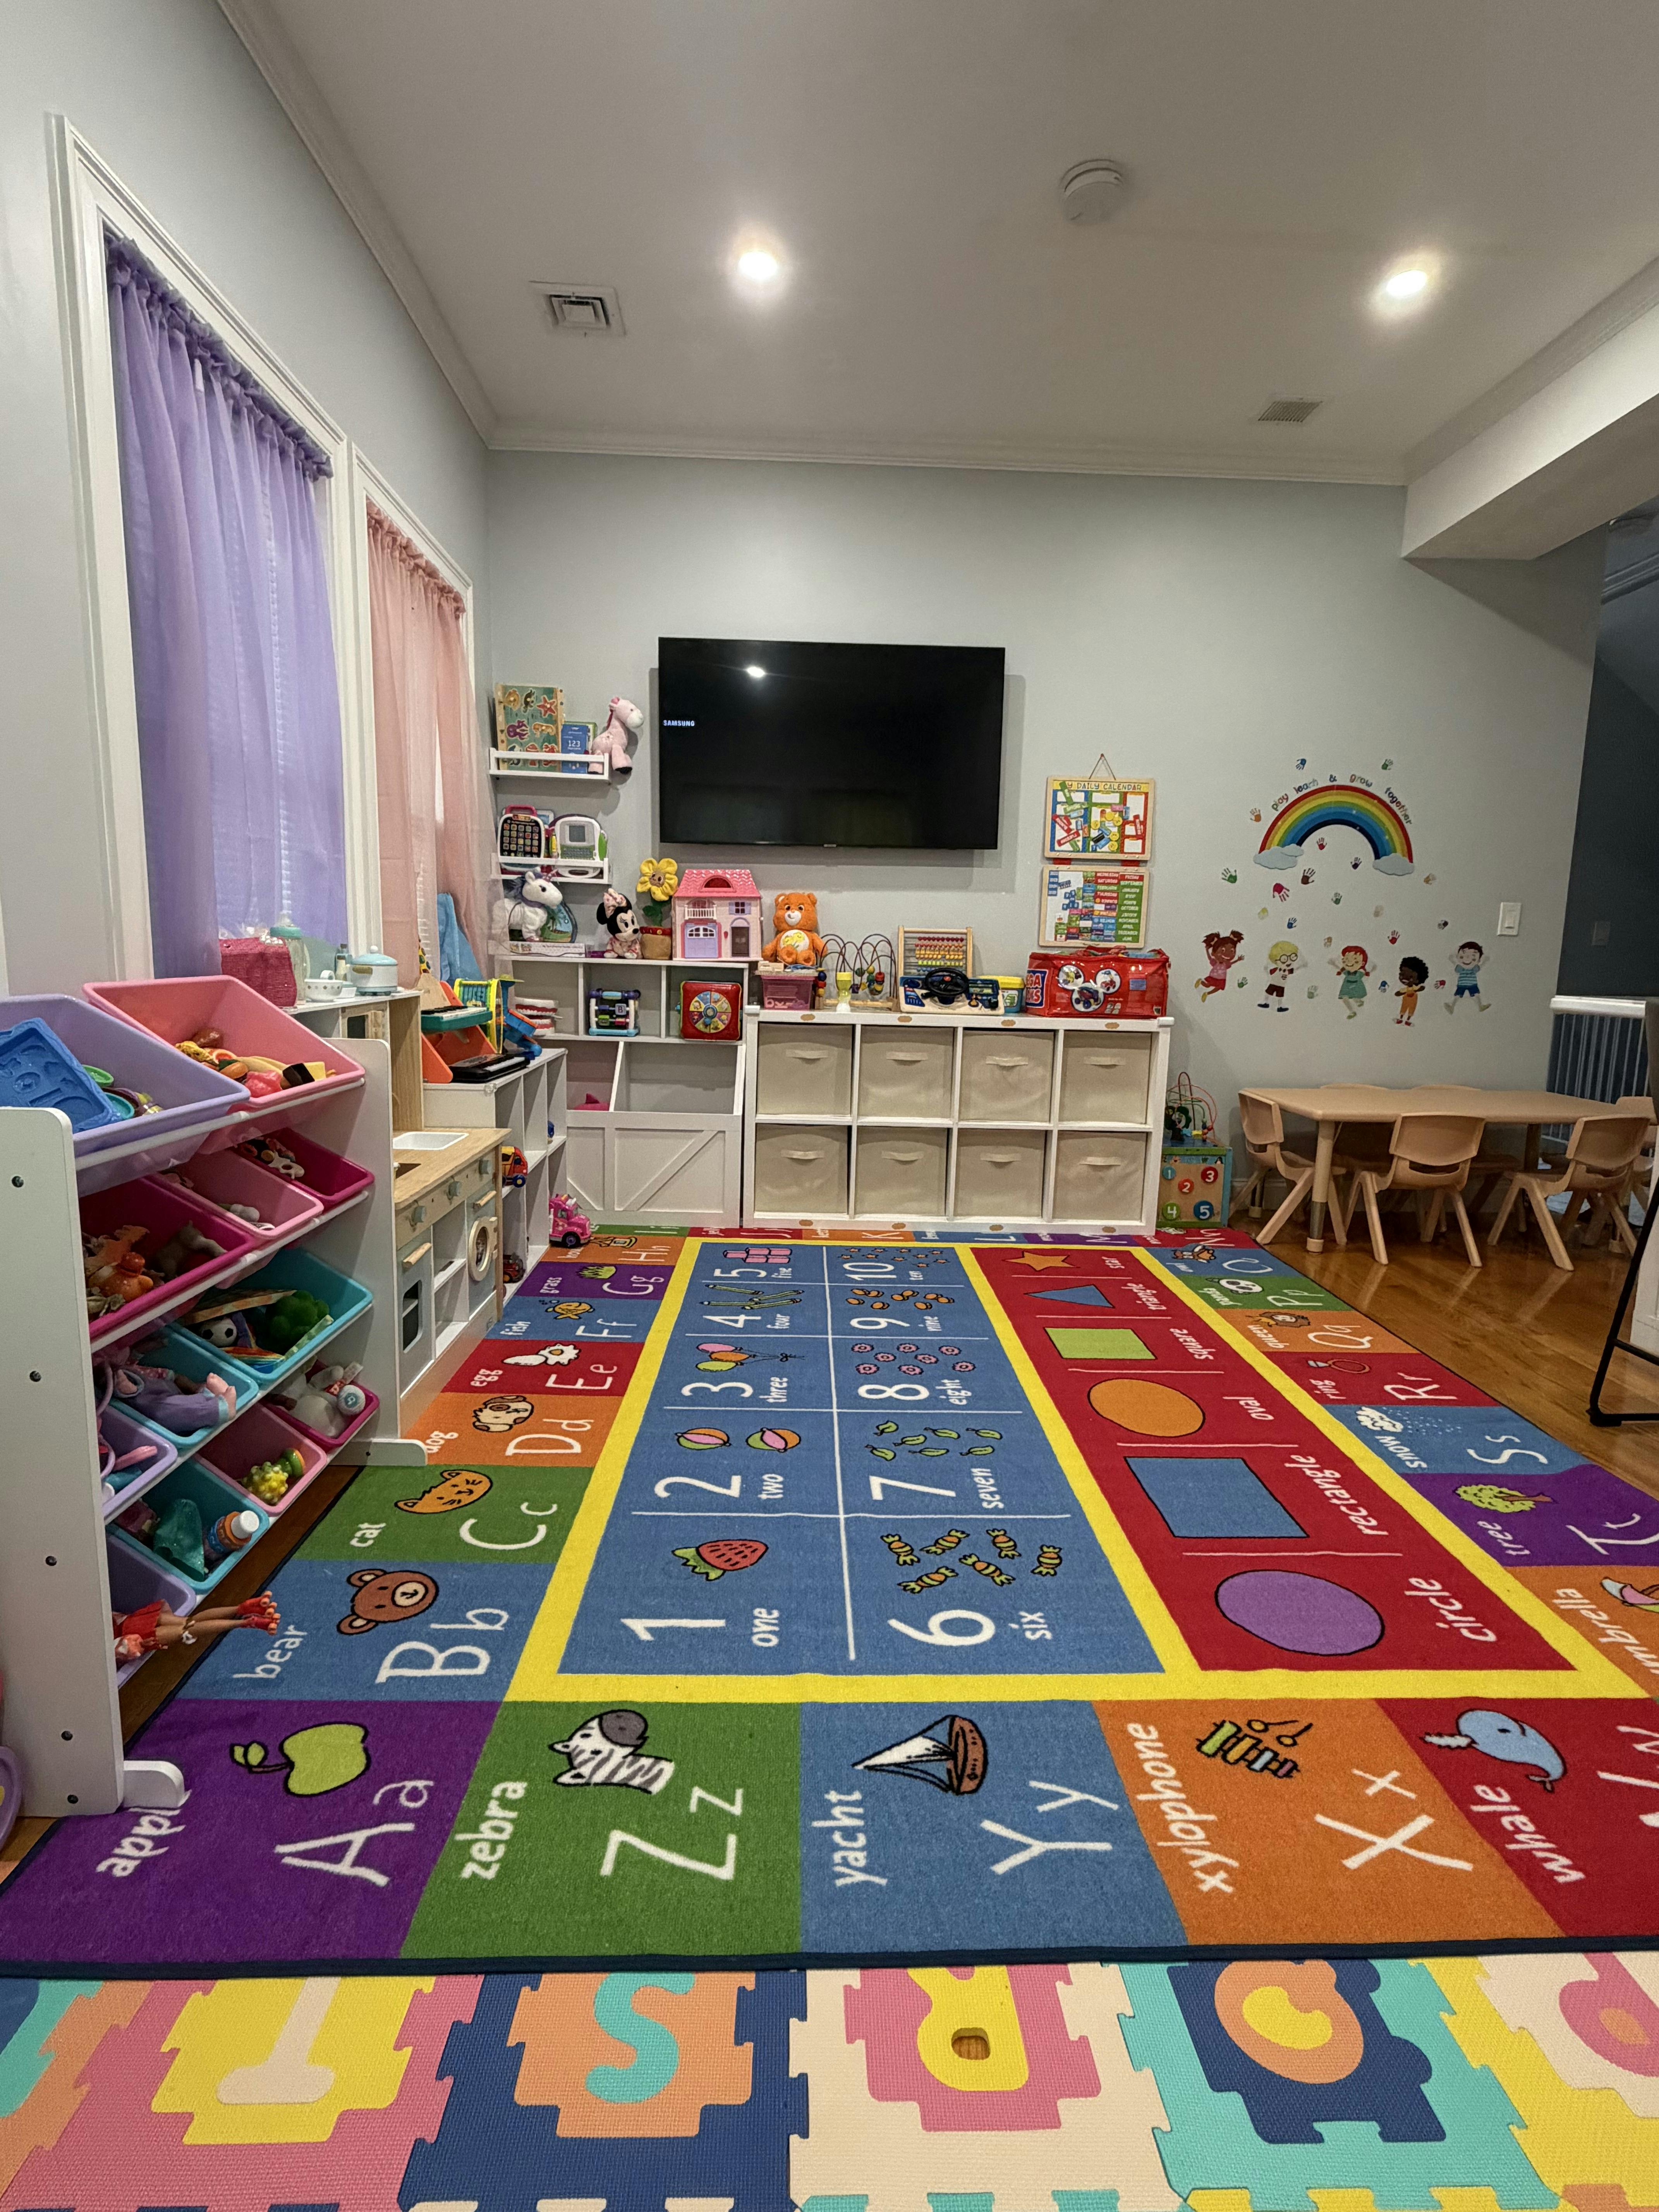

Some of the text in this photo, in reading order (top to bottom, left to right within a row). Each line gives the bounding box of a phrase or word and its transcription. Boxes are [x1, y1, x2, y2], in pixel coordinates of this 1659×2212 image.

[1272, 793, 1289, 812] play
[1329, 774, 1337, 783] &
[1350, 774, 1373, 788] grow
[1384, 787, 1412, 825] together
[1026, 973, 1042, 988] EGA
[1182, 1182, 1190, 1193] 2
[1201, 1170, 1214, 1182] 3
[1167, 1206, 1177, 1219] 4
[1199, 1206, 1210, 1219] 5
[714, 1269, 766, 1277] 5
[771, 1268, 792, 1278] five
[843, 1262, 896, 1280] 10
[1102, 1257, 1125, 1268] star
[540, 1278, 562, 1293] grass
[909, 1271, 923, 1280] ten
[1121, 1283, 1167, 1310] triangle
[1205, 1286, 1242, 1307] panda
[500, 1321, 531, 1335] fish
[575, 1319, 636, 1338] Ff
[703, 1314, 761, 1328] 4
[766, 1314, 790, 1329] four
[850, 1317, 910, 1329] 9
[924, 1316, 941, 1331] nine
[1170, 1329, 1216, 1359] square
[1247, 1325, 1285, 1348] queen
[471, 1369, 503, 1386] egg
[546, 1365, 617, 1389] Ee
[1309, 1379, 1346, 1399] ring
[682, 1382, 753, 1397] 3
[759, 1377, 788, 1402] three
[858, 1384, 929, 1400] 8
[936, 1379, 972, 1405] eight
[1223, 1397, 1274, 1420] oval
[505, 1419, 594, 1456] Dd
[1375, 1436, 1427, 1468] snow
[1467, 1436, 1547, 1464] Ss
[654, 1475, 741, 1498] 2
[758, 1474, 783, 1499] two
[869, 1476, 956, 1500] 7
[979, 1468, 1004, 1508] seven
[1284, 1453, 1389, 1536] rectangle
[350, 1523, 386, 1547] cat
[460, 1502, 557, 1550] Cc
[1477, 1520, 1531, 1557] tree
[1405, 1578, 1496, 1642] circle
[621, 1619, 725, 1640] 1
[752, 1608, 779, 1647] one
[888, 1609, 995, 1646] 6
[1009, 1611, 1052, 1640] six
[1552, 1588, 1659, 1674] mbrella
[233, 1625, 307, 1678] bear
[375, 1608, 509, 1683] Bb
[1127, 1723, 1239, 1893] xylophone
[95, 1789, 192, 1877] appl
[275, 1780, 433, 1886] Aa
[457, 1781, 527, 1880] zebra
[812, 1791, 887, 1886] yacht
[1470, 1785, 1585, 1883] whale
[584, 1971, 695, 2104] S
